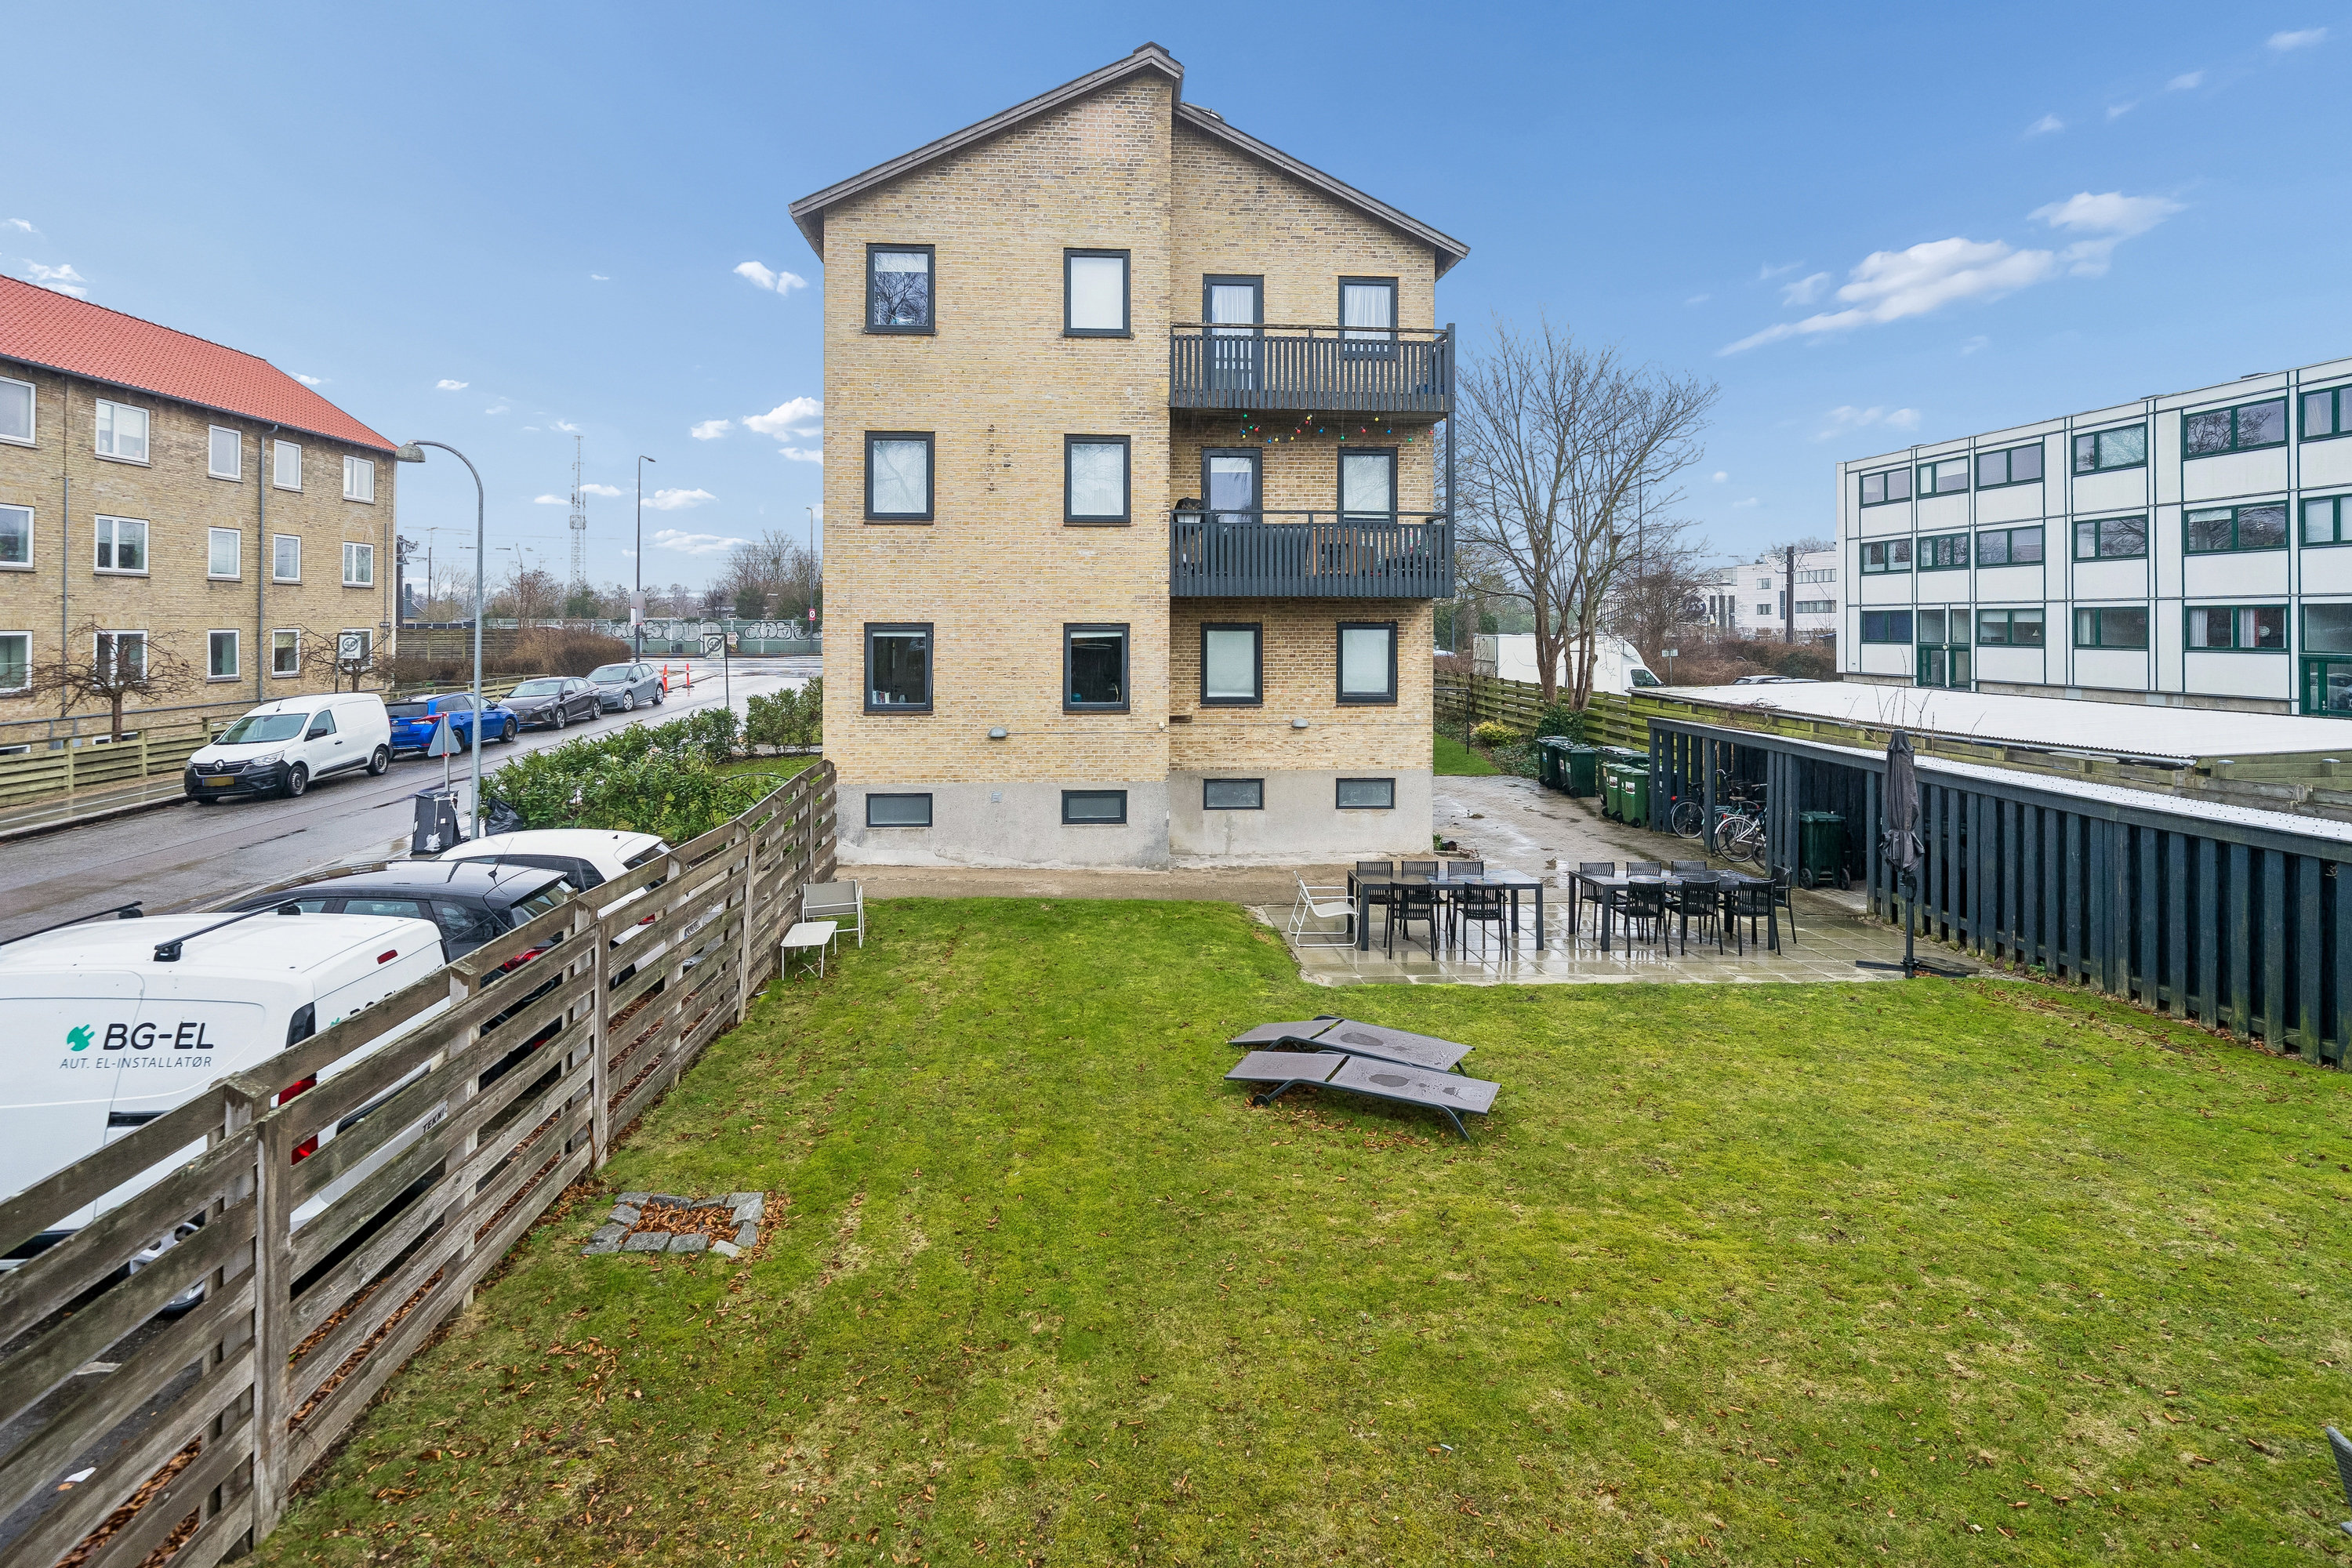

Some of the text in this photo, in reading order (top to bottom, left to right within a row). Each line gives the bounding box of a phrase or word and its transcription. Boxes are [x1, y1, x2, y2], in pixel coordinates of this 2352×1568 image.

[103, 1022, 214, 1051] BG-EL
[60, 1056, 212, 1069] AUT. EL-INSTALLATØR
